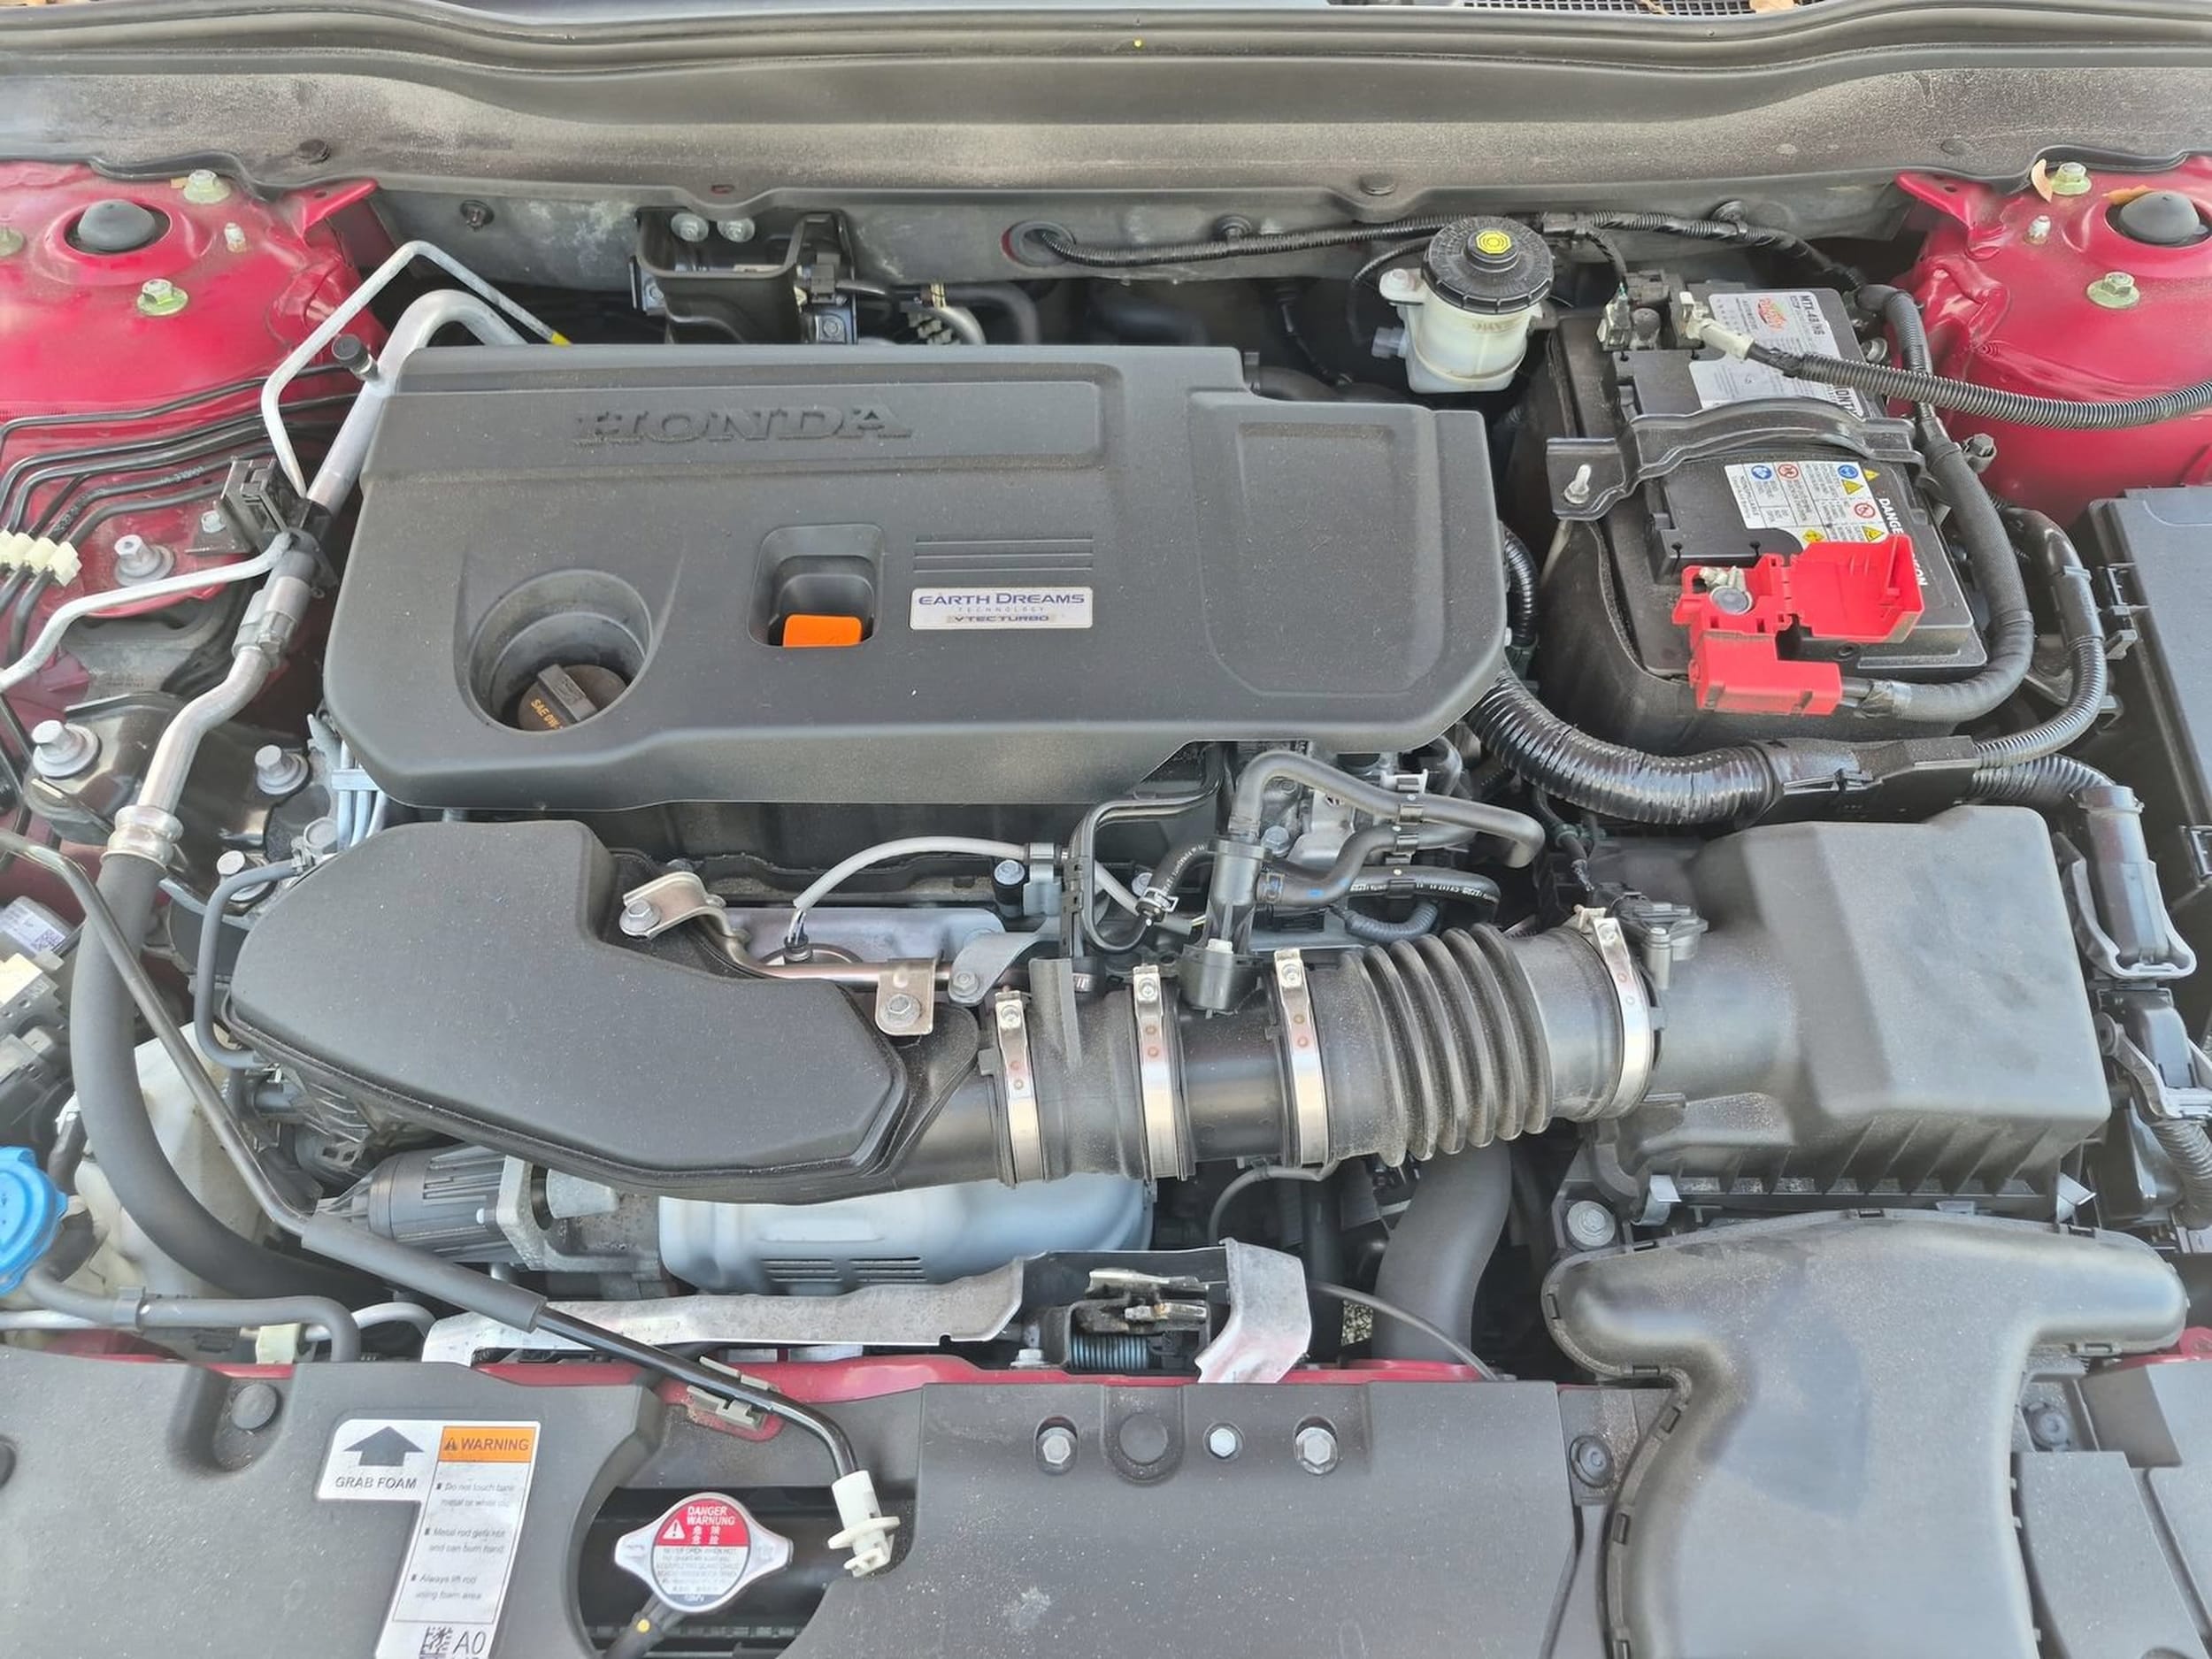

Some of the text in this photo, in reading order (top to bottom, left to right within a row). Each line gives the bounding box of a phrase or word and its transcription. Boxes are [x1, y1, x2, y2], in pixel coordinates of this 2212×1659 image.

[575, 406, 912, 445] HONDA
[1877, 497, 1904, 534] DANGE
[918, 593, 1086, 606] EARTH DREAMS
[530, 698, 549, 717] SAE
[461, 1438, 529, 1451] WARNING
[334, 1476, 419, 1490] GRAB FOAM
[687, 1506, 727, 1516] DANGER
[687, 1516, 736, 1526] WARNUNG
[419, 1575, 449, 1585] Always
[452, 1631, 487, 1655] A0
